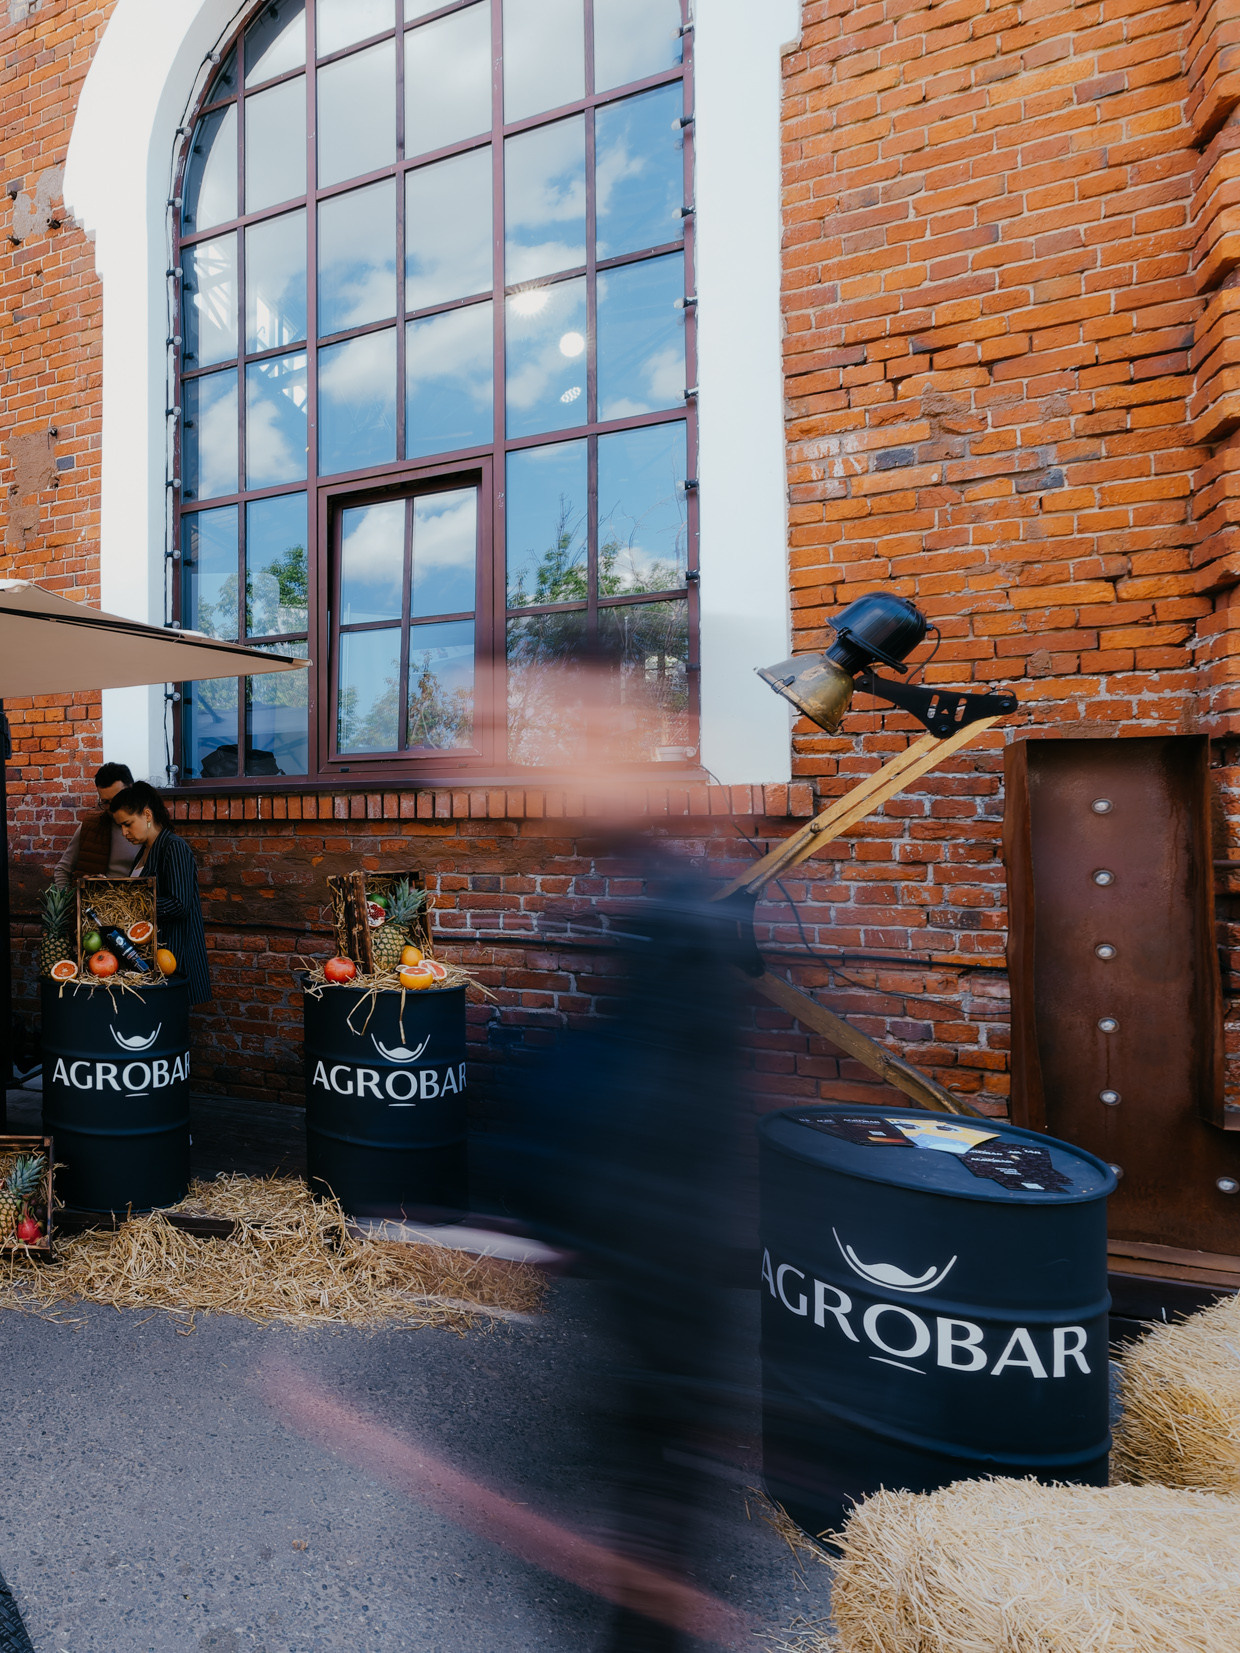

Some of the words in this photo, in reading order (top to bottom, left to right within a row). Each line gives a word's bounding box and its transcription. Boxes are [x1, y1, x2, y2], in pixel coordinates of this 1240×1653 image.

[52, 1050, 191, 1091] AGROBAR
[312, 1060, 467, 1100] AGROBAR
[761, 1247, 1092, 1379] AGROBAR
